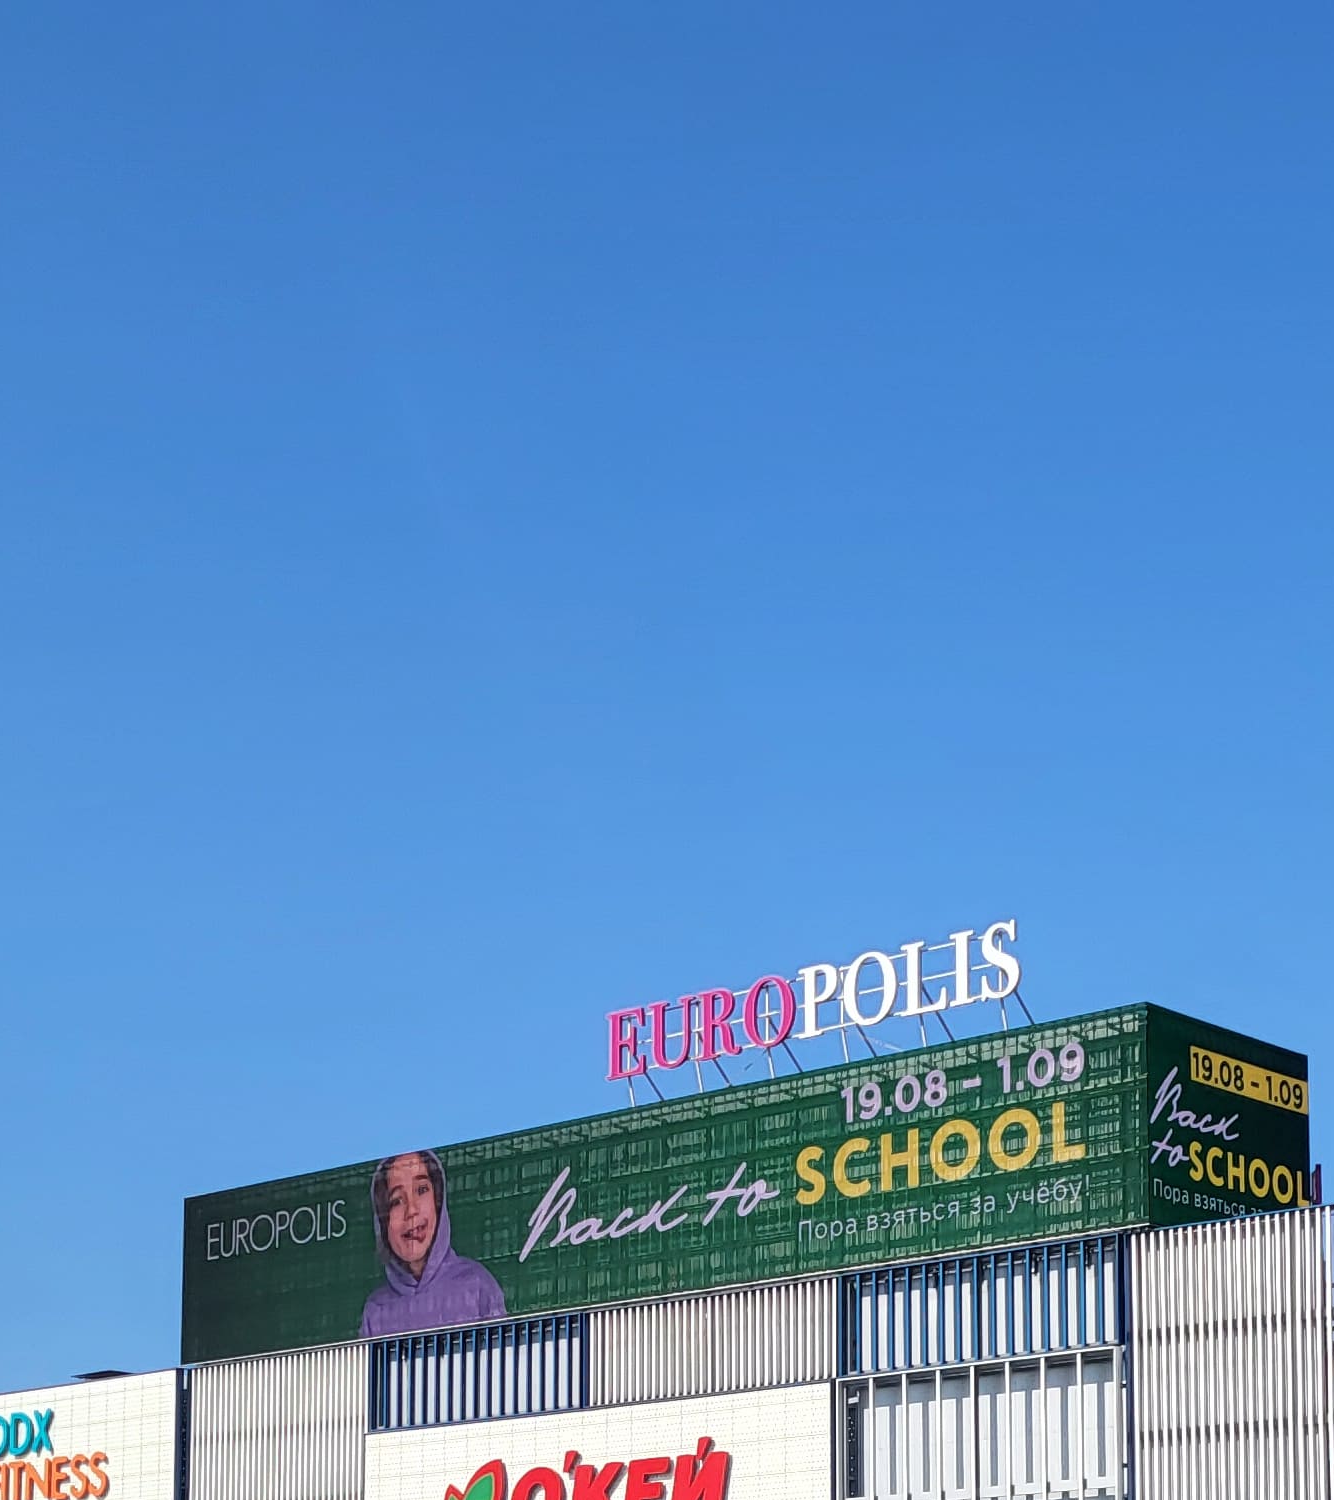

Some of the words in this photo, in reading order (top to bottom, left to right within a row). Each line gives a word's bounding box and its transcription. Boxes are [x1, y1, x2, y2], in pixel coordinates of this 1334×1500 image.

[606, 919, 1021, 1081] EUROPOLIS
[841, 1069, 948, 1123] 19.08
[997, 1042, 1086, 1094] 1.09
[1150, 1066, 1240, 1141] Back
[1192, 1052, 1245, 1092] 19.08
[1265, 1075, 1304, 1109] 1.09
[519, 1166, 688, 1263] Back
[702, 1161, 781, 1225] to
[795, 1101, 1086, 1206] SCHOOL
[1151, 1128, 1189, 1168] to
[1189, 1141, 1310, 1207] SCHOOL
[1153, 1178, 1189, 1204] Пора
[1194, 1193, 1246, 1217] взяться
[205, 1199, 348, 1262] EUROPOLIS
[798, 1214, 857, 1242] Пора
[867, 1199, 961, 1232] взяться
[971, 1197, 996, 1215] за
[1006, 1174, 1091, 1214] учёбу!
